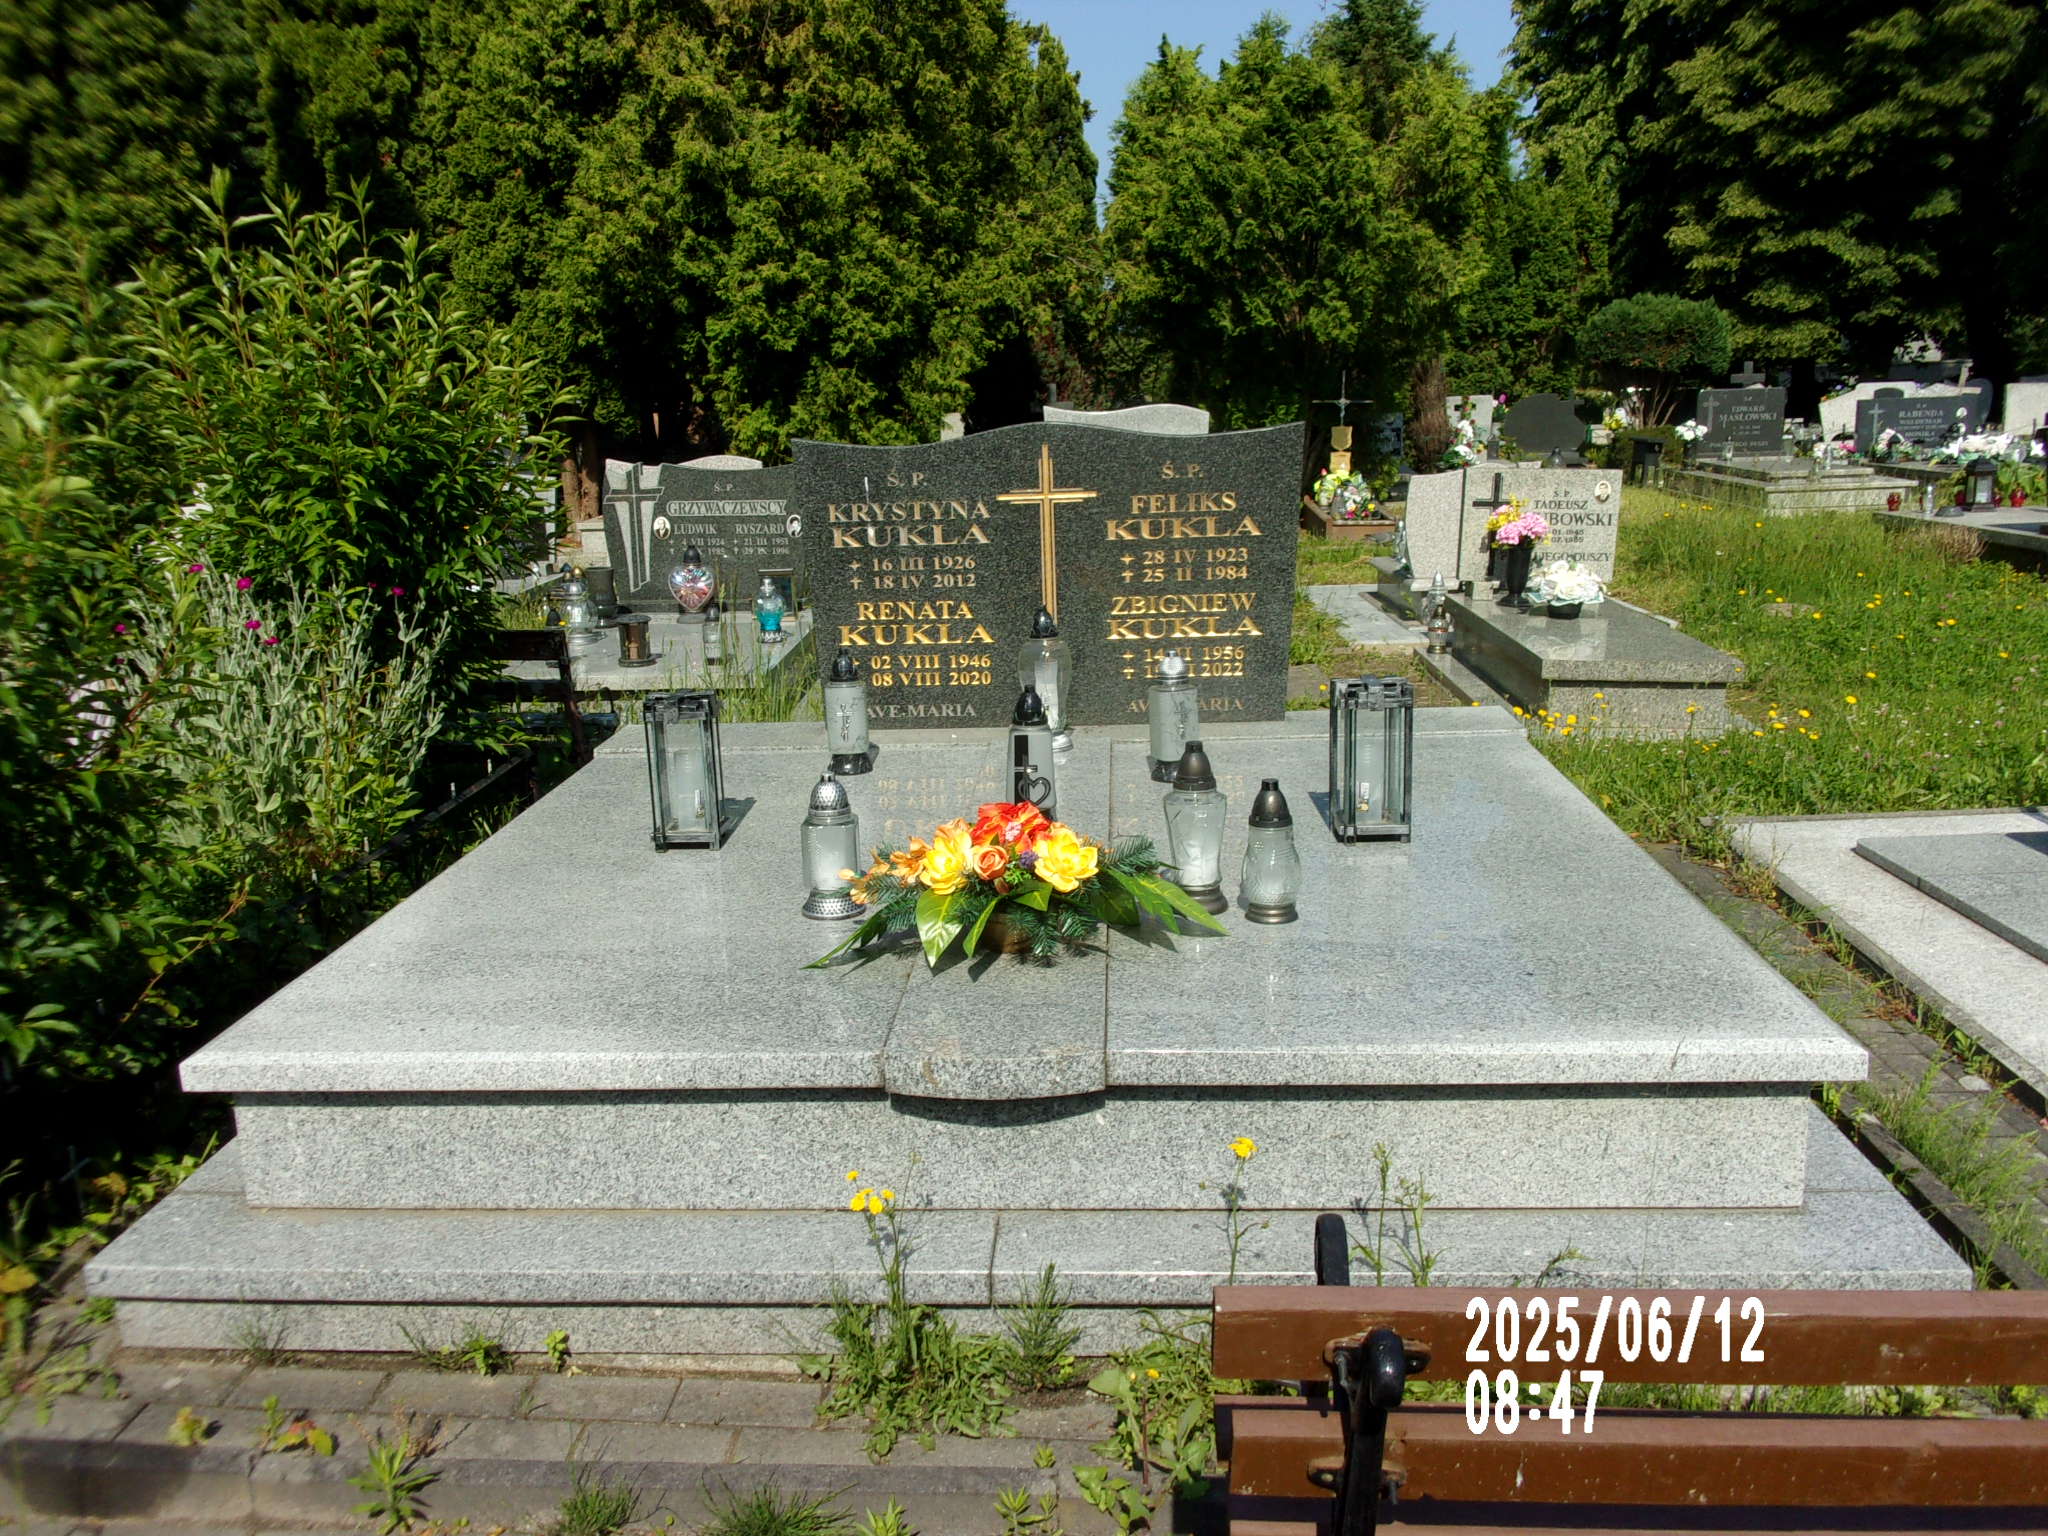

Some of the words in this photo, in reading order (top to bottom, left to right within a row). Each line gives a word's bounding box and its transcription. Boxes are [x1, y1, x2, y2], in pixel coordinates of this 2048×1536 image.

[666, 500, 787, 516] GRZYWACZEWSCY
[827, 500, 991, 522] KRYSTYNA
[1130, 492, 1238, 514] FELIKS
[1534, 500, 1588, 510] TADEUSZ
[674, 524, 717, 535] LUDWIK
[735, 524, 785, 535] RYSZARD
[832, 523, 991, 548] KUKLA
[1105, 515, 1264, 541] KUKLA
[873, 557, 893, 571] 16
[901, 556, 924, 571] III
[933, 554, 976, 570] 1926
[1142, 550, 1165, 565] 28
[1174, 549, 1196, 564] IV
[1206, 547, 1248, 562] 1923
[873, 575, 894, 589] 18
[901, 575, 924, 589] IV
[933, 573, 976, 588] 2012
[1142, 568, 1165, 582] 25
[1177, 567, 1193, 582] II
[1206, 565, 1248, 580] 1984
[857, 600, 976, 621] RENATA
[1111, 592, 1257, 615] ZBIGNIEW
[838, 623, 997, 646] KUKLA
[1106, 616, 1264, 640] KUKLA
[871, 655, 892, 669] 02
[898, 654, 940, 669] VIII
[951, 653, 992, 669] 1946
[1144, 648, 1165, 662] 14
[1202, 645, 1245, 661] 1956
[1200, 662, 1245, 677] 2022
[872, 673, 893, 687] 08
[899, 672, 942, 687] VIII
[950, 671, 993, 686] 2020
